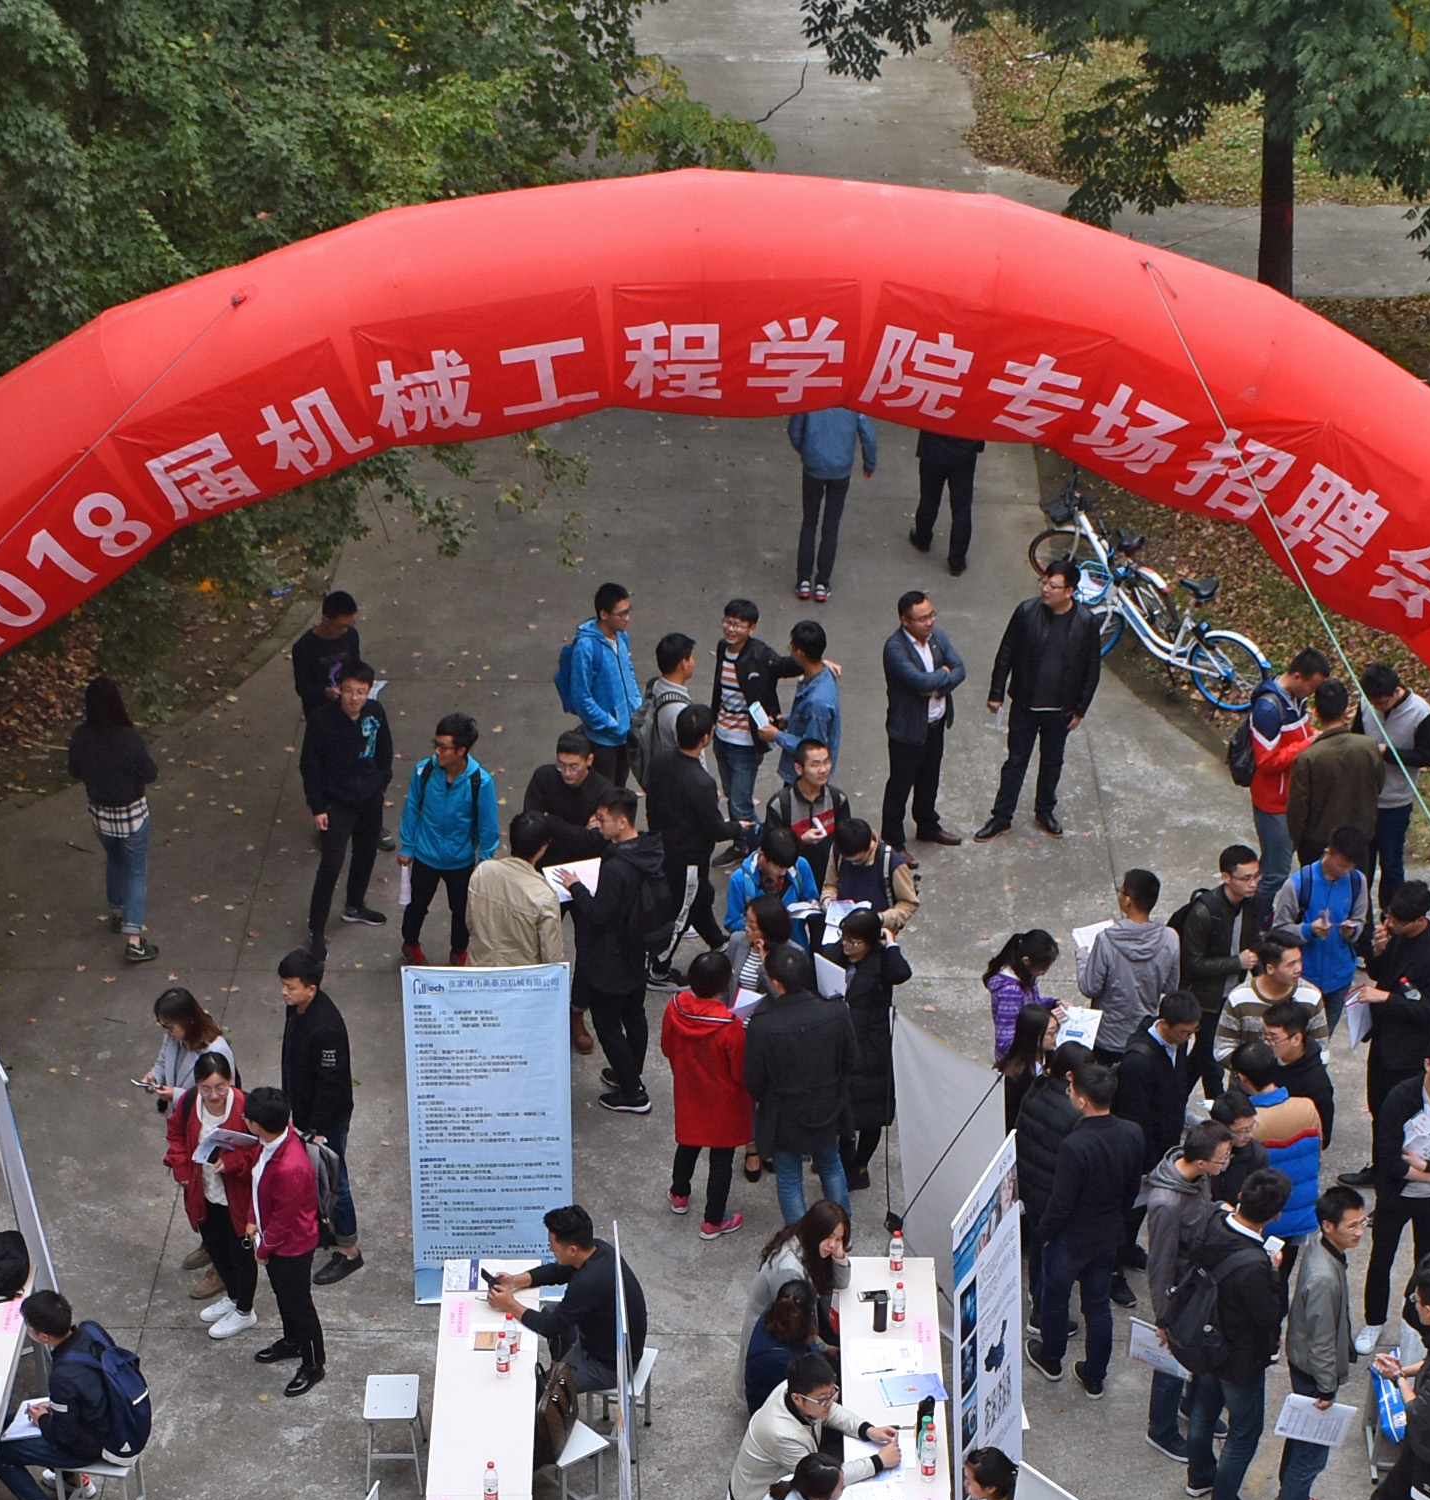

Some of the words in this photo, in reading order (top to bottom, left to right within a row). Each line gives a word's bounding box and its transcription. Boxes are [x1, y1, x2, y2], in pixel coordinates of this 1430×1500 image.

[449, 978, 559, 987] 张家港市美泰克机械有限公司
